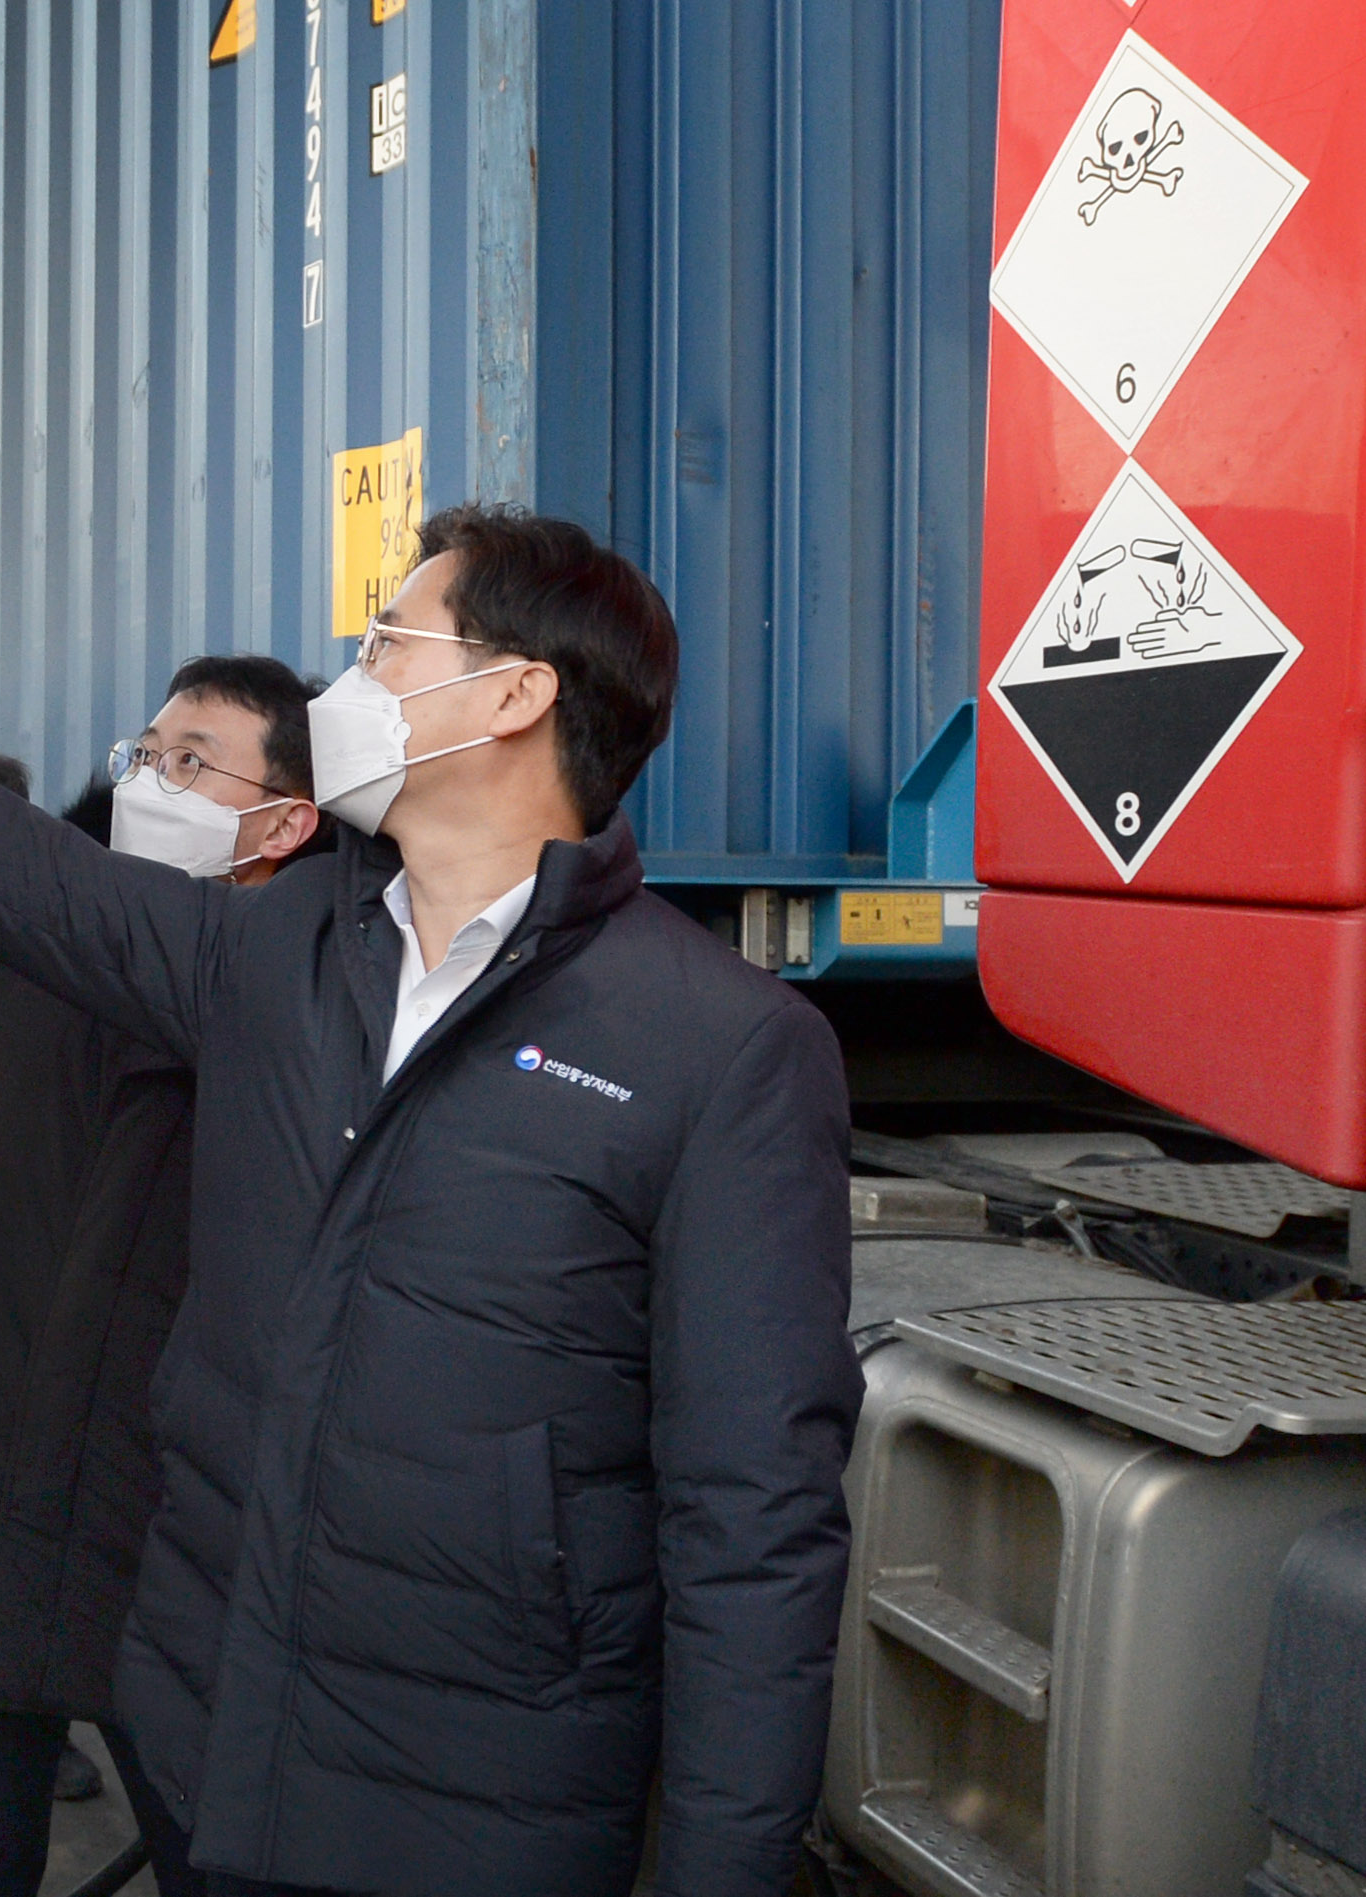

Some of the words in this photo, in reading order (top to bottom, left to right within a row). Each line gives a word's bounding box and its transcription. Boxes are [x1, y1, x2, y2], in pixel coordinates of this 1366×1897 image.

[305, 0, 322, 236] 7494
[382, 131, 403, 164] 33
[305, 262, 321, 325] 7
[1116, 362, 1136, 404] 6
[1115, 792, 1141, 837] 8
